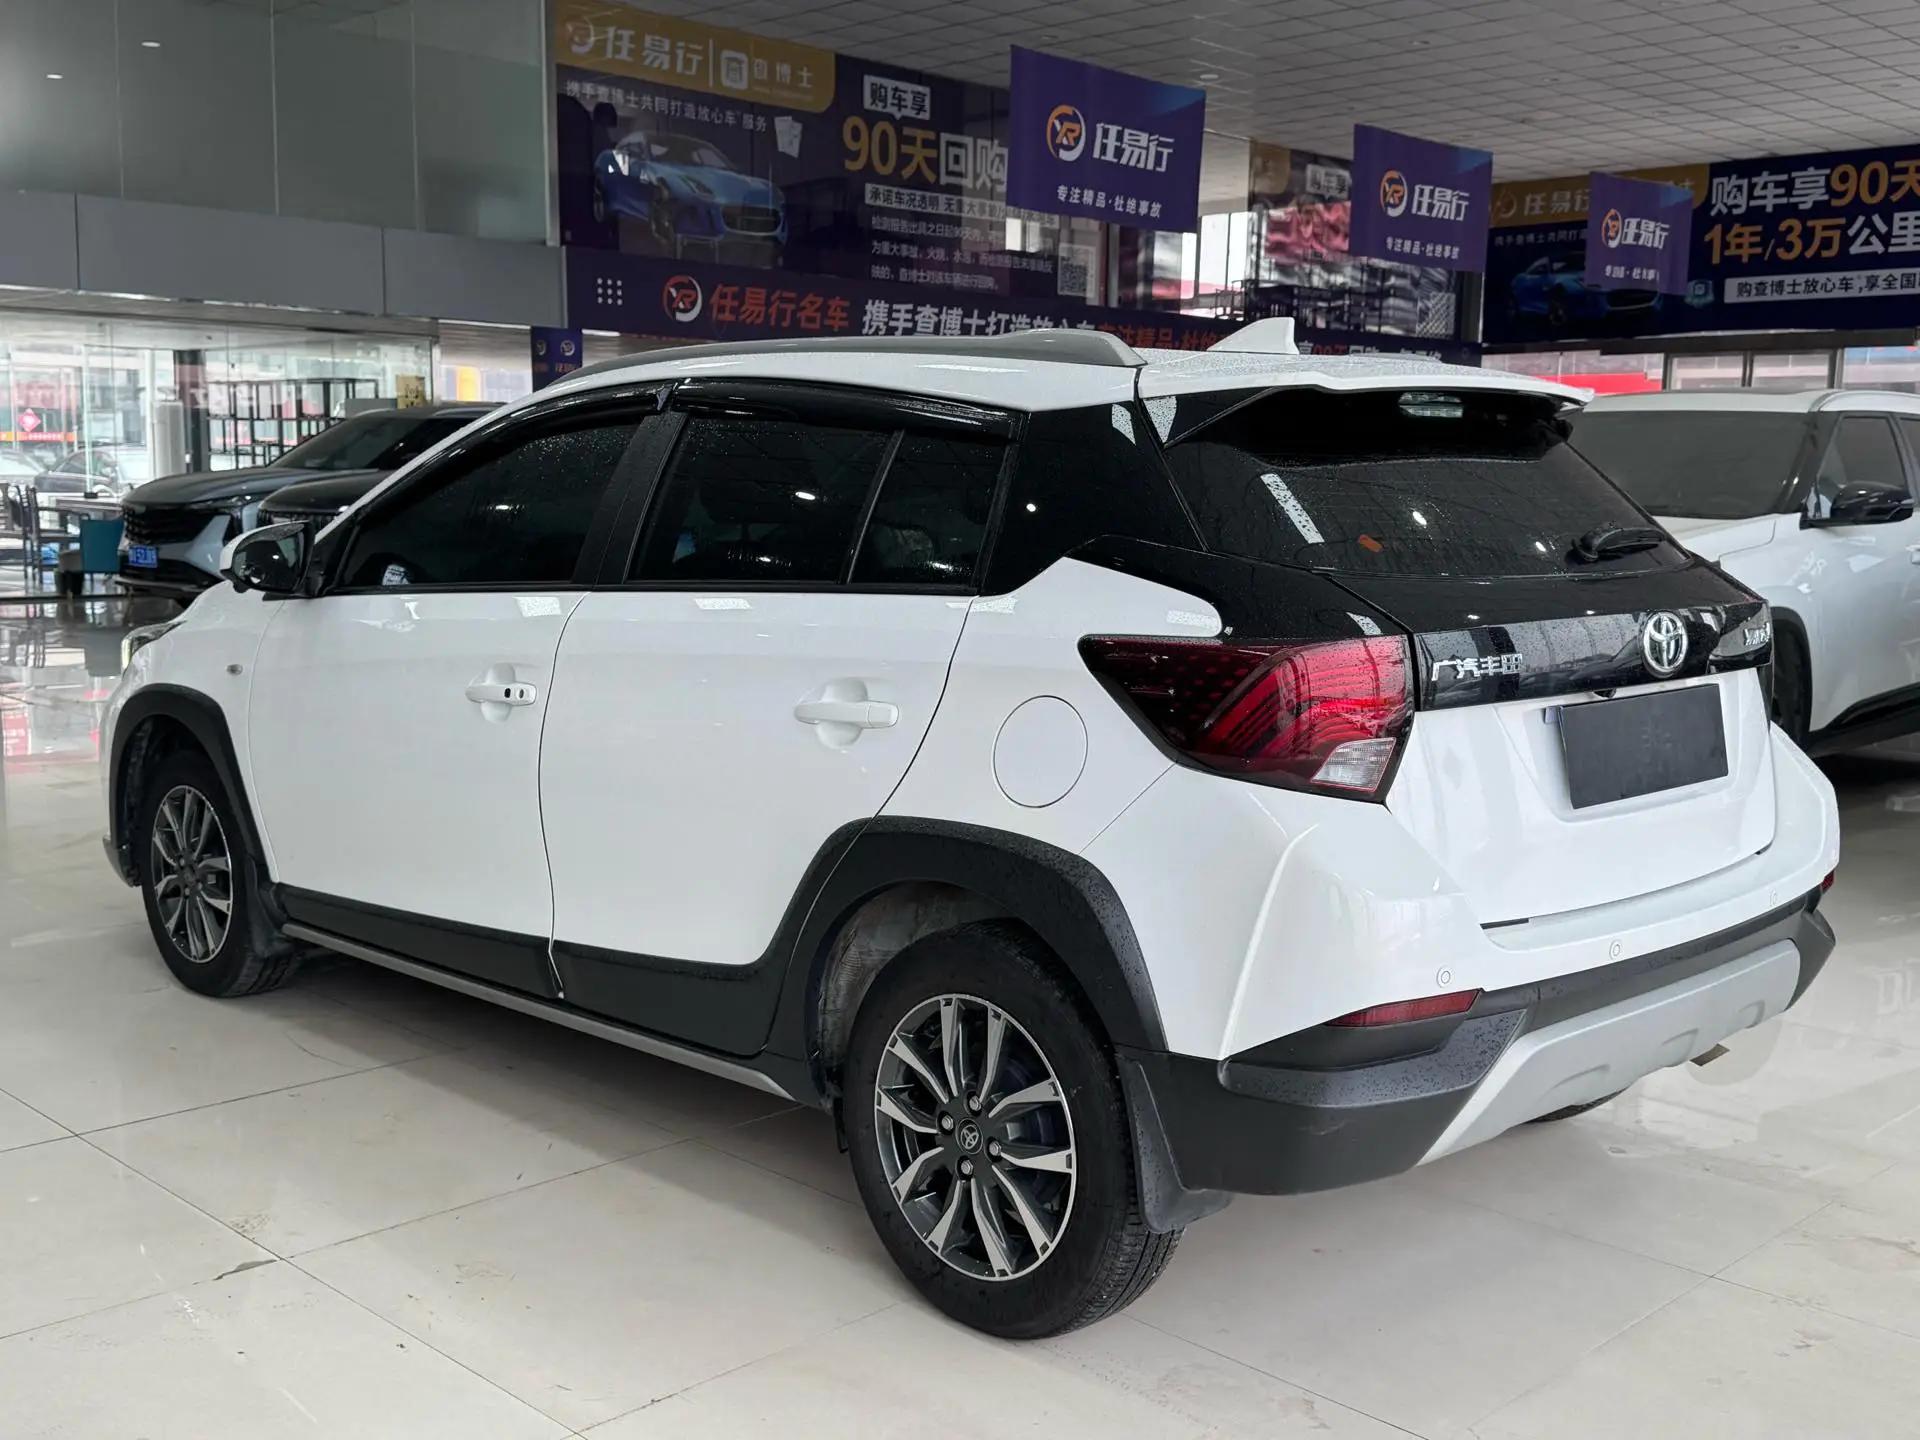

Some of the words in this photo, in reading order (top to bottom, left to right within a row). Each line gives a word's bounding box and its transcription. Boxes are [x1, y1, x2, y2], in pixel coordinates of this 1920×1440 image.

[605, 26, 704, 76] 任易行
[869, 81, 928, 117] 购车享
[1092, 122, 1175, 173] 任易行
[1411, 184, 1470, 221] 任易行
[1621, 217, 1671, 250] 任易行
[709, 283, 851, 332] 任易行名车
[1431, 653, 1523, 682] 广汽丰田
